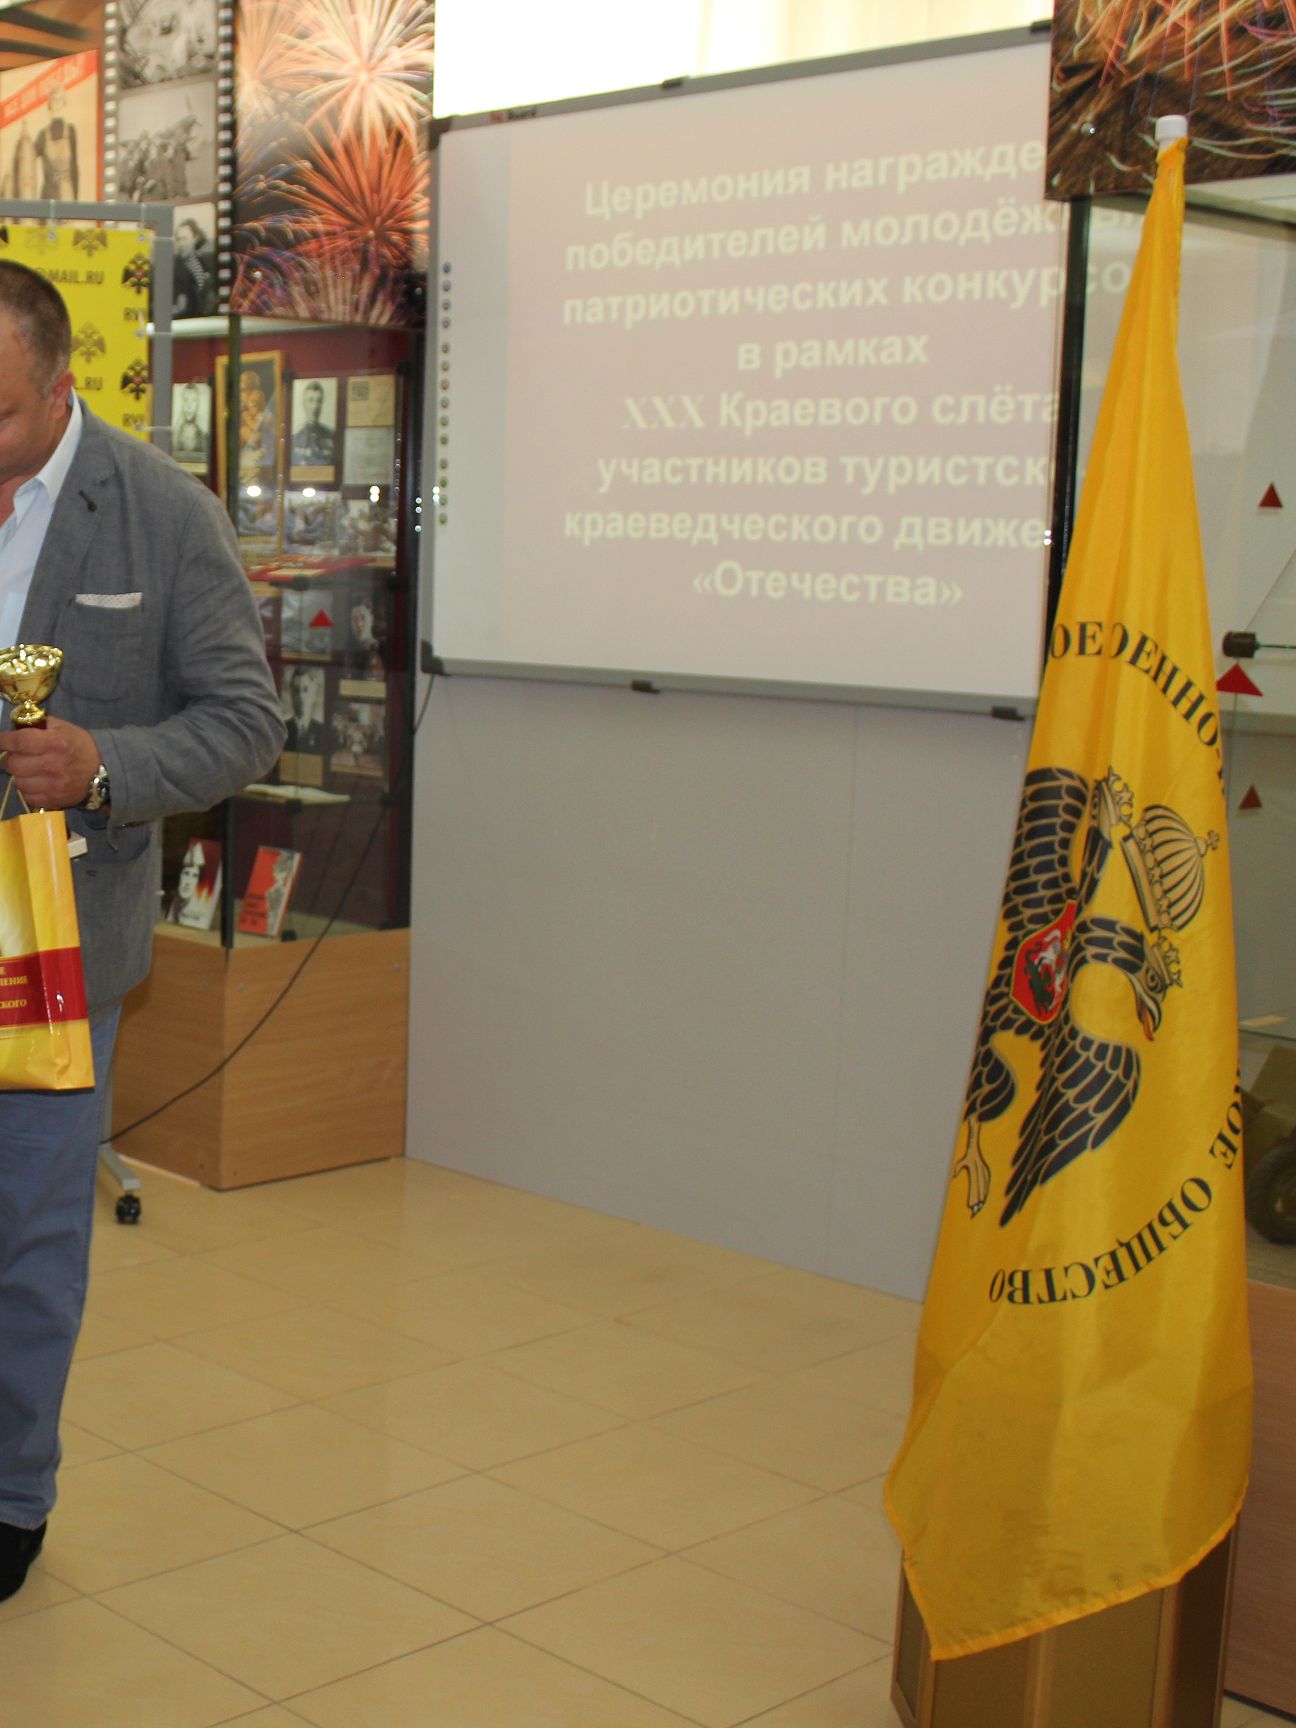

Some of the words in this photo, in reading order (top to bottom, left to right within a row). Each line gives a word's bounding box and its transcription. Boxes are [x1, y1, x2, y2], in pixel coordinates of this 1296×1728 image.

[584, 163, 811, 219] Церемония
[566, 215, 825, 270] победителей
[562, 274, 888, 330] патриотических
[737, 342, 762, 370] в
[775, 333, 929, 378] рамках
[718, 391, 918, 438] Краевого
[596, 453, 828, 494] участников
[564, 510, 884, 547] краеведческого
[692, 559, 963, 608] «Отечества»
[989, 1177, 1213, 1305] ОБЩЕСТВО
